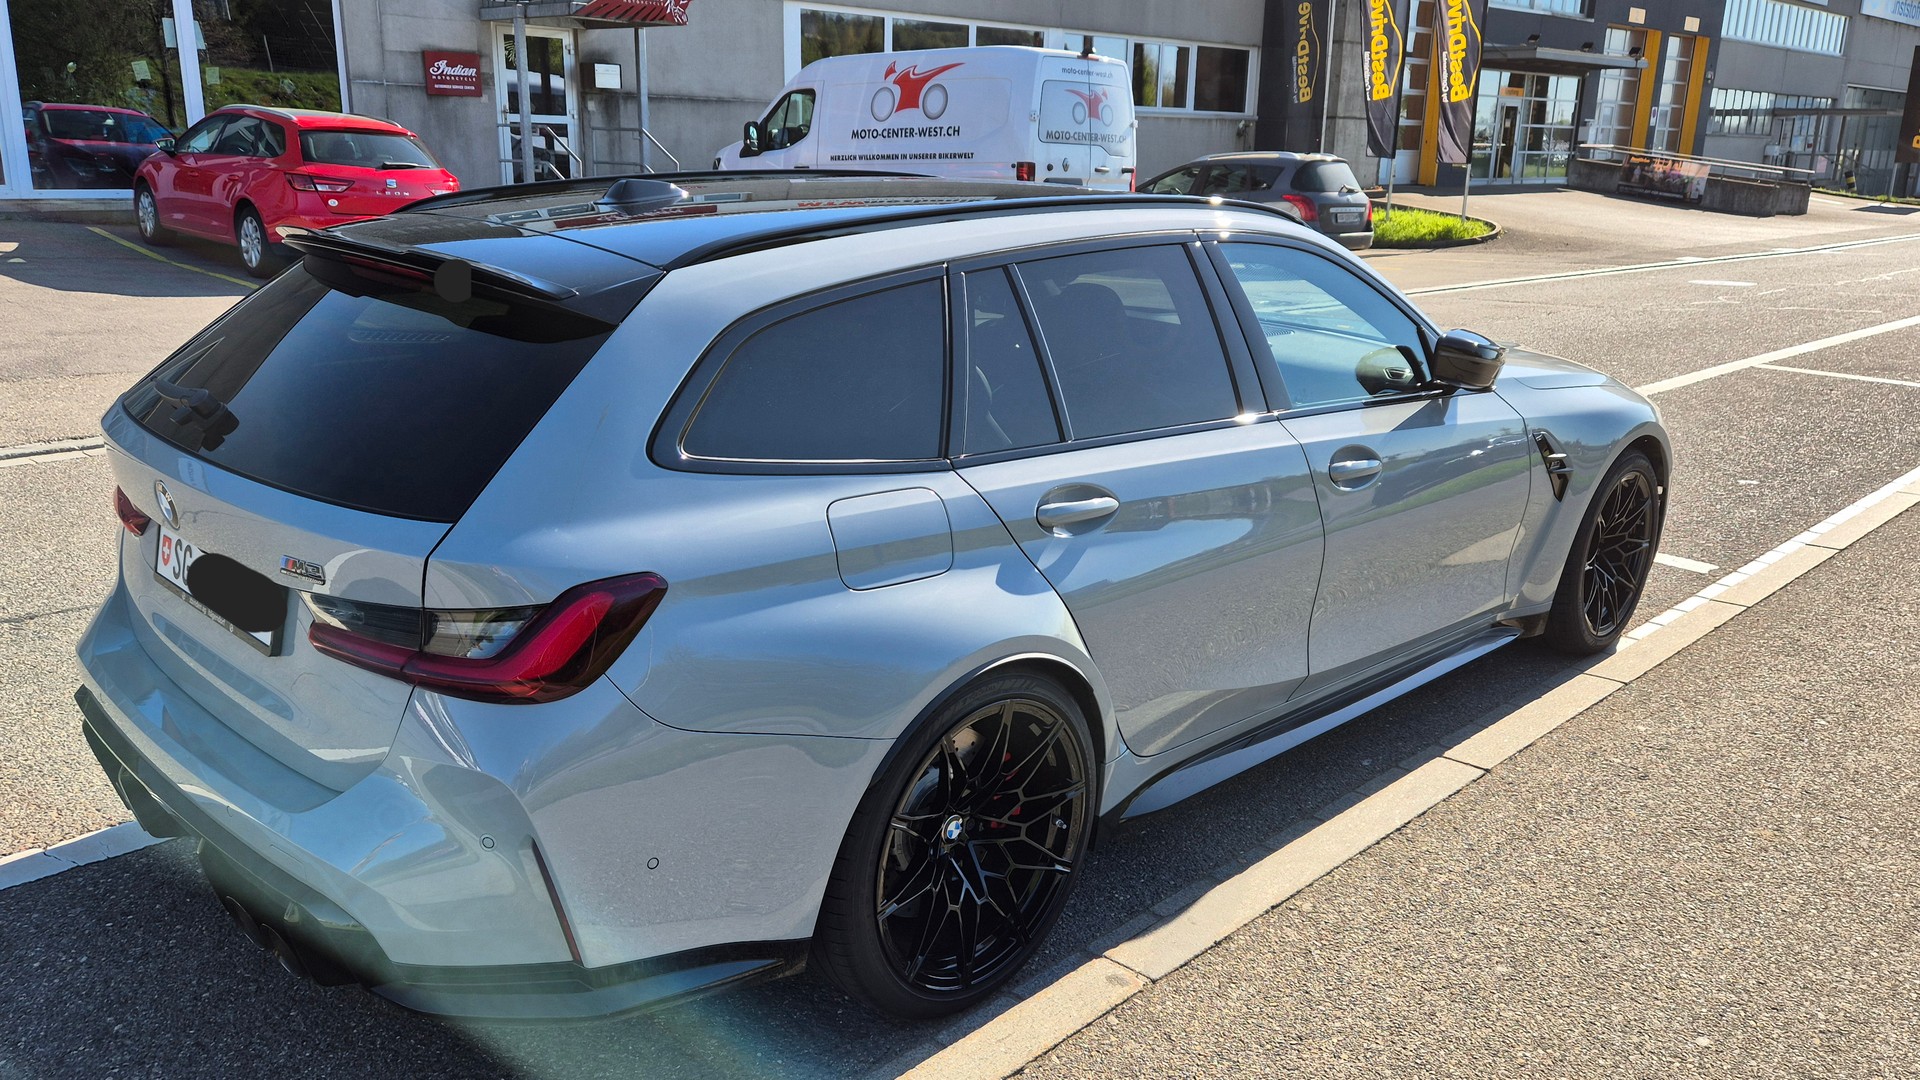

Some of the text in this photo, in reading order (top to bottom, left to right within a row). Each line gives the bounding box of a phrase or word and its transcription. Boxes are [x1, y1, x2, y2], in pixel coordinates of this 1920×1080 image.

[430, 60, 477, 77] Indian
[1061, 67, 1113, 79] moto-center-west.ch
[851, 125, 960, 140] MOTO-CENTER-WEST.CH
[1045, 129, 1127, 144] MOTO-CENTER-WEST.CH
[830, 154, 857, 162] HERZLICH
[858, 153, 899, 161] WILLKOMMEN
[908, 152, 937, 160] UNSERER
[938, 151, 975, 159] BIKERWELT
